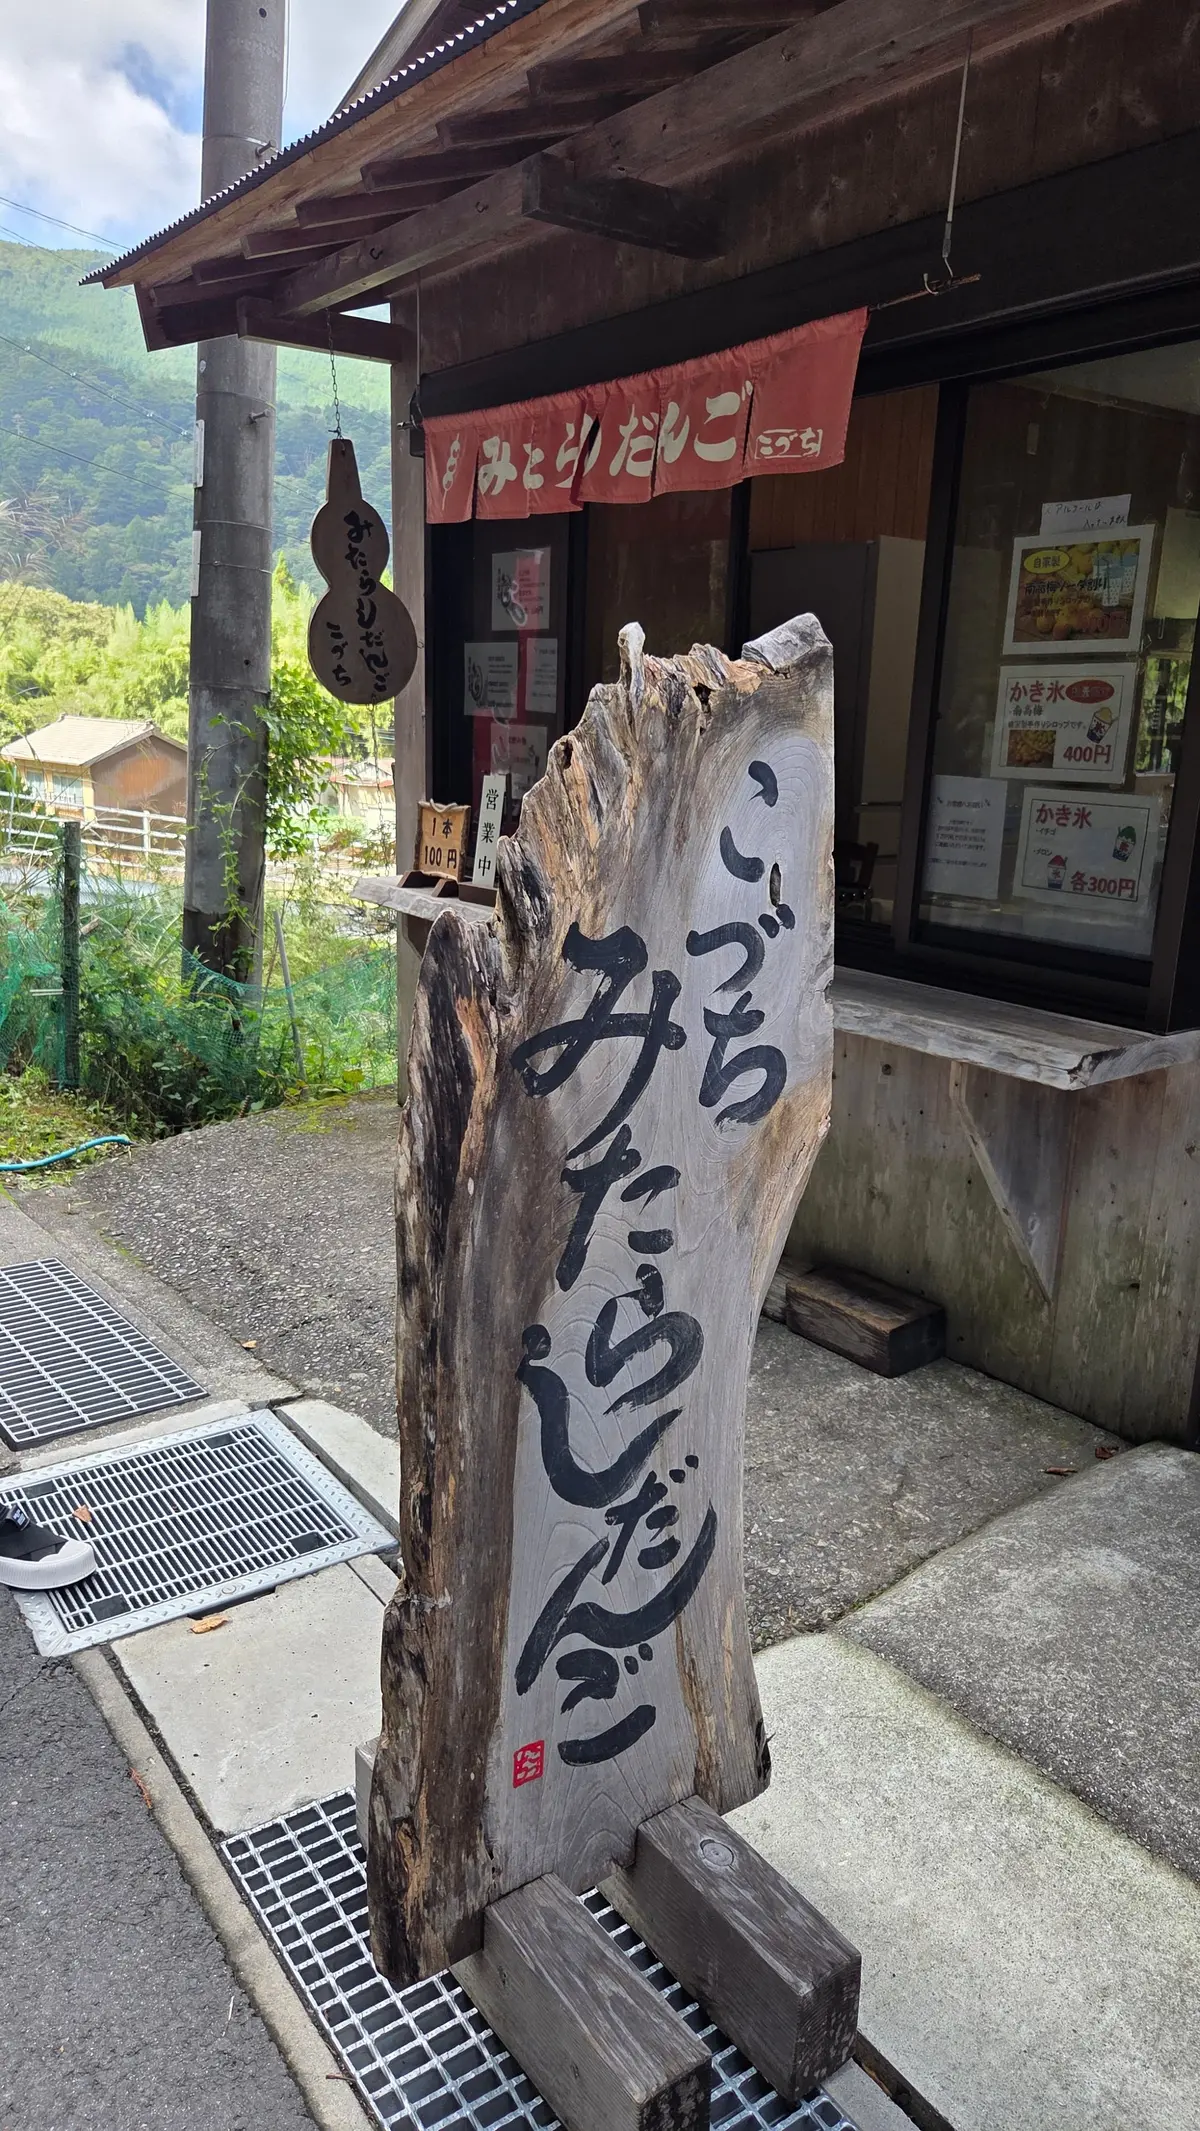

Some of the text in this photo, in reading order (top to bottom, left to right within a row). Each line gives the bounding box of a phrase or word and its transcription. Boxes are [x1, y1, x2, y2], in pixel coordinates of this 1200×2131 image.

[1033, 555, 1061, 569] 自家製
[343, 510, 389, 693] みたらしだんご
[325, 621, 353, 686] こづち
[1009, 680, 1066, 703] かき氷
[1062, 744, 1112, 764] 400円
[431, 817, 453, 839] 1本
[1035, 803, 1092, 829] かき氷
[478, 788, 499, 877] 営業中
[424, 845, 457, 870] 100円
[1070, 870, 1137, 898] 各300円
[686, 760, 796, 1132] こづち
[509, 921, 718, 1767] みたらしだんご
